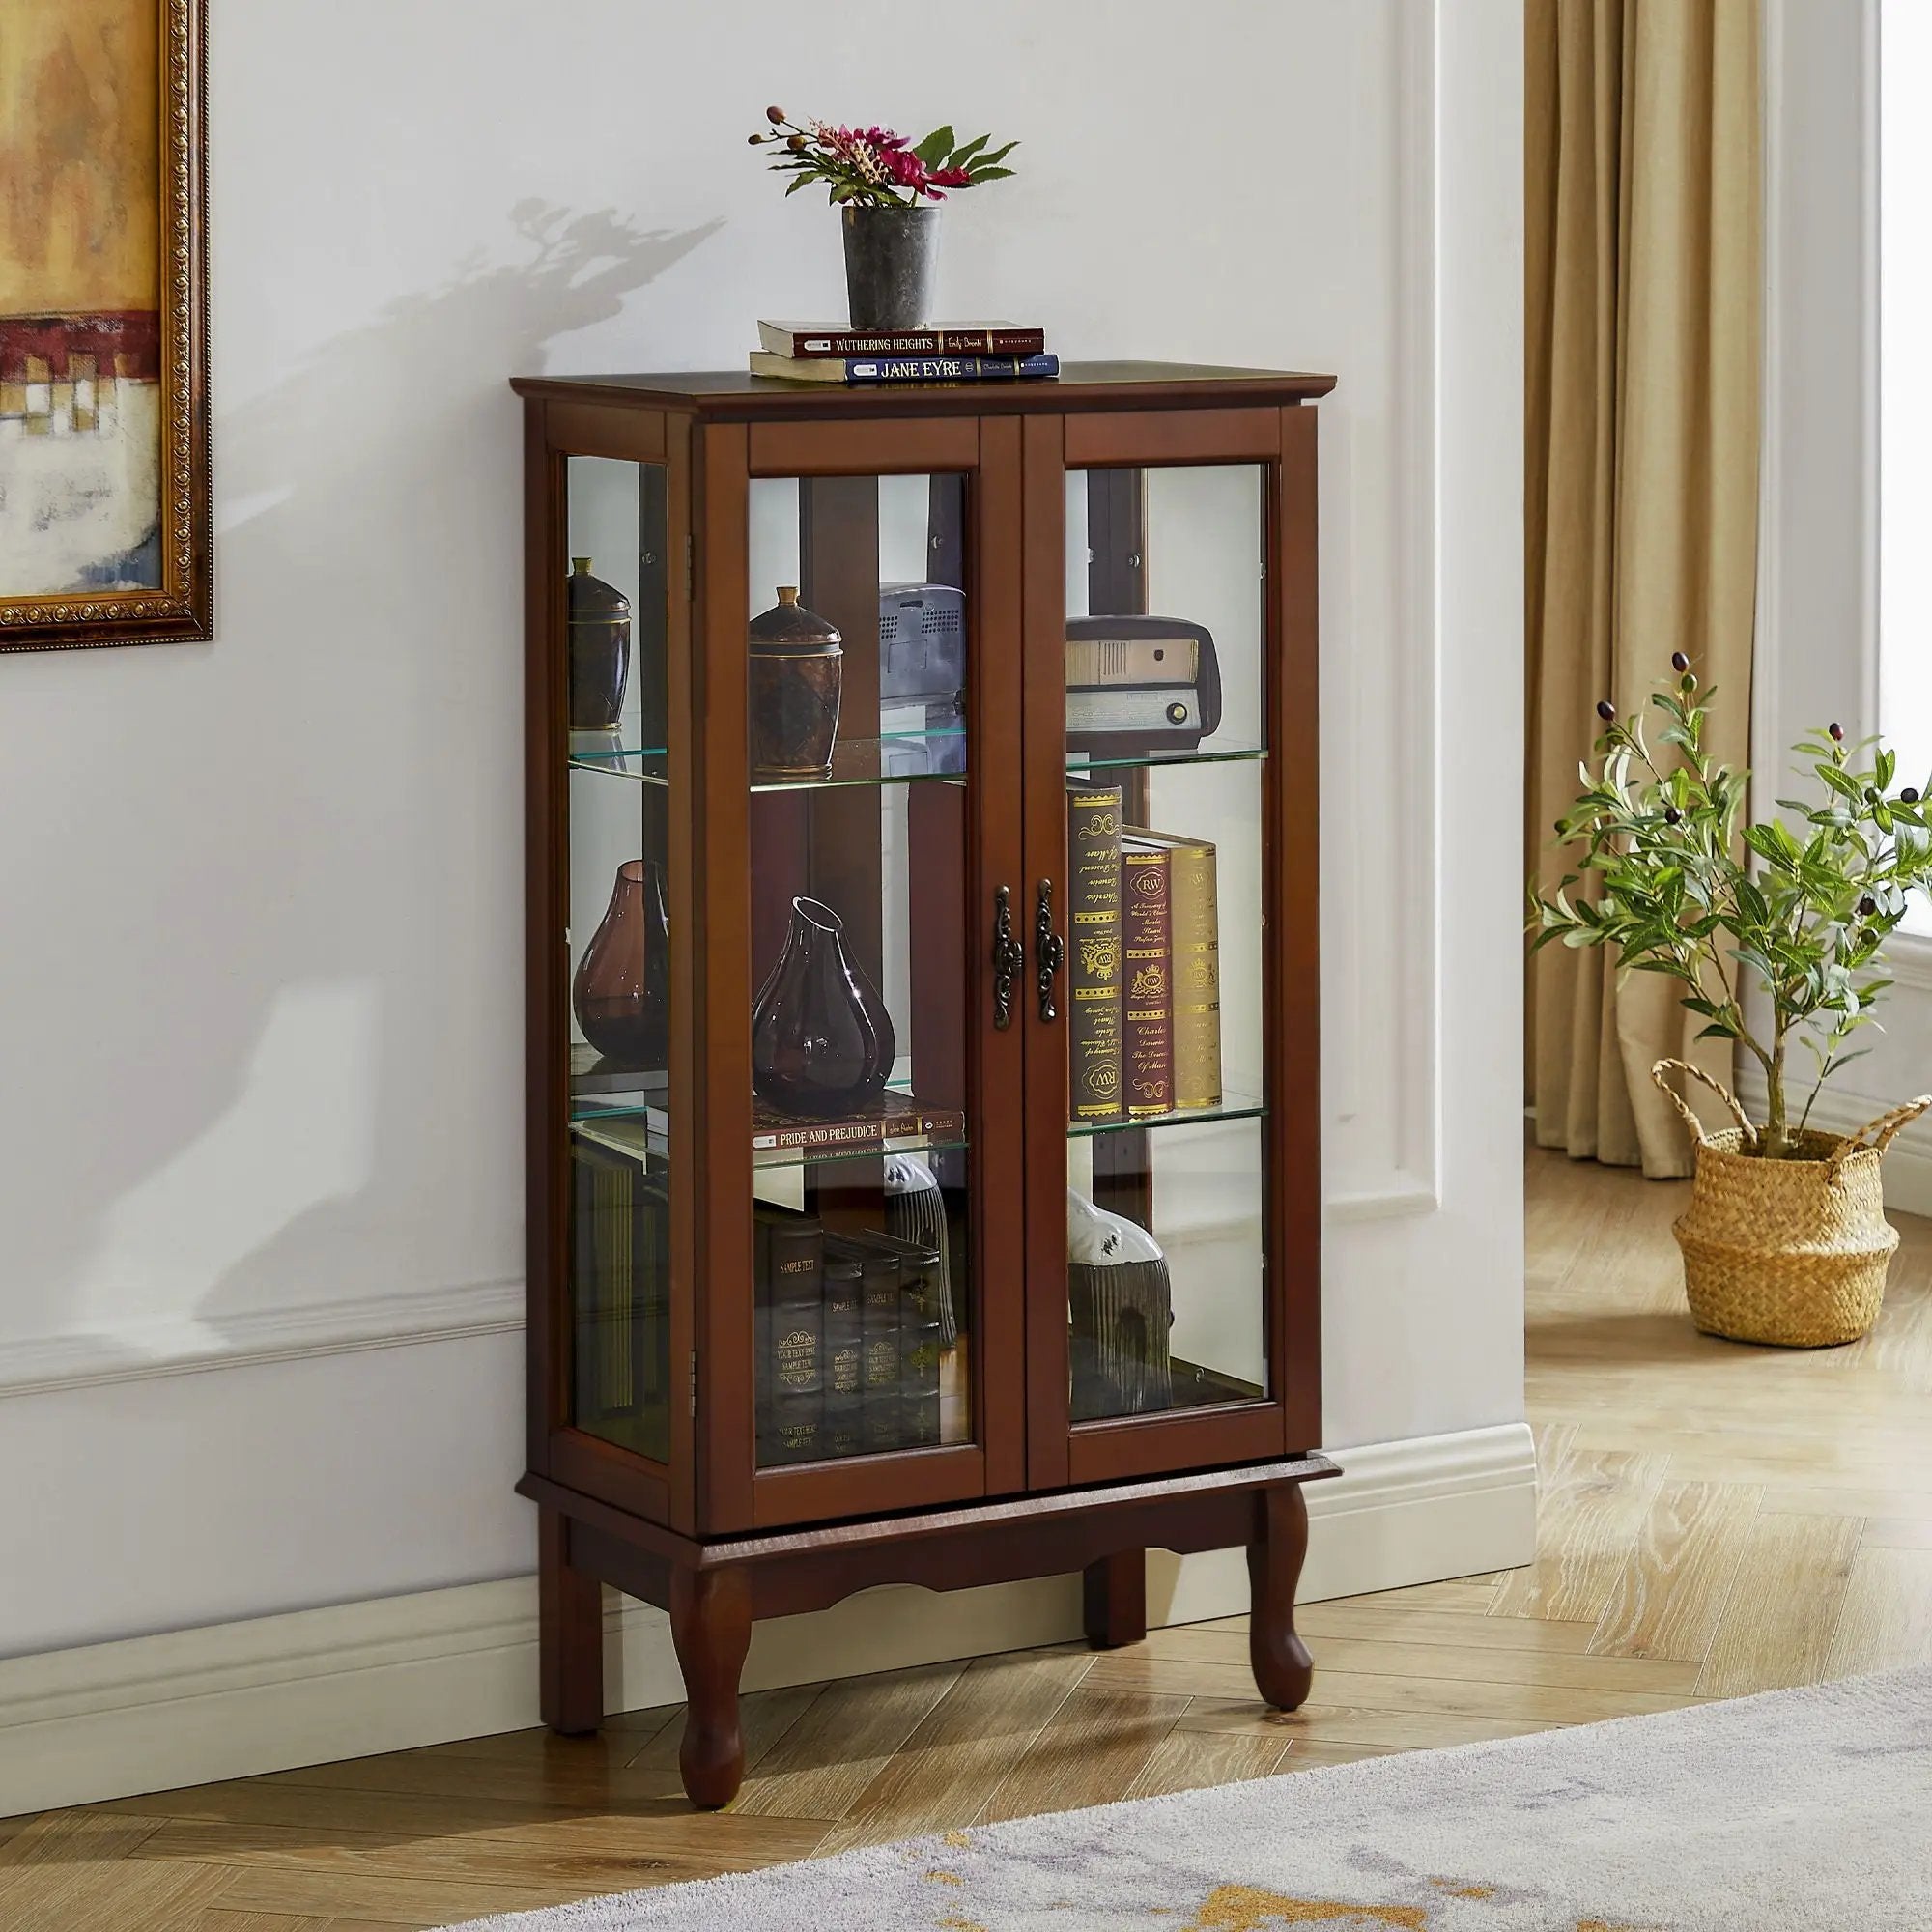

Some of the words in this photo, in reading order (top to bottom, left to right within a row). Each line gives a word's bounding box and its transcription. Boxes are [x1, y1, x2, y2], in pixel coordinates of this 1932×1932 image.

[835, 338, 891, 351] WUTHERING
[893, 338, 934, 350] HEIGHTS
[948, 337, 962, 350] Emily
[881, 362, 920, 378] JANE
[923, 359, 962, 377] EYRE
[1143, 879, 1161, 891] RW
[1085, 893, 1118, 904] Charles
[1096, 1071, 1116, 1086] RW
[780, 1131, 808, 1146] PRIDE
[809, 1130, 828, 1143] AND
[829, 1124, 878, 1141] PREJUDICE
[781, 1260, 802, 1274] SAMPLE
[802, 1259, 814, 1271] TEXT
